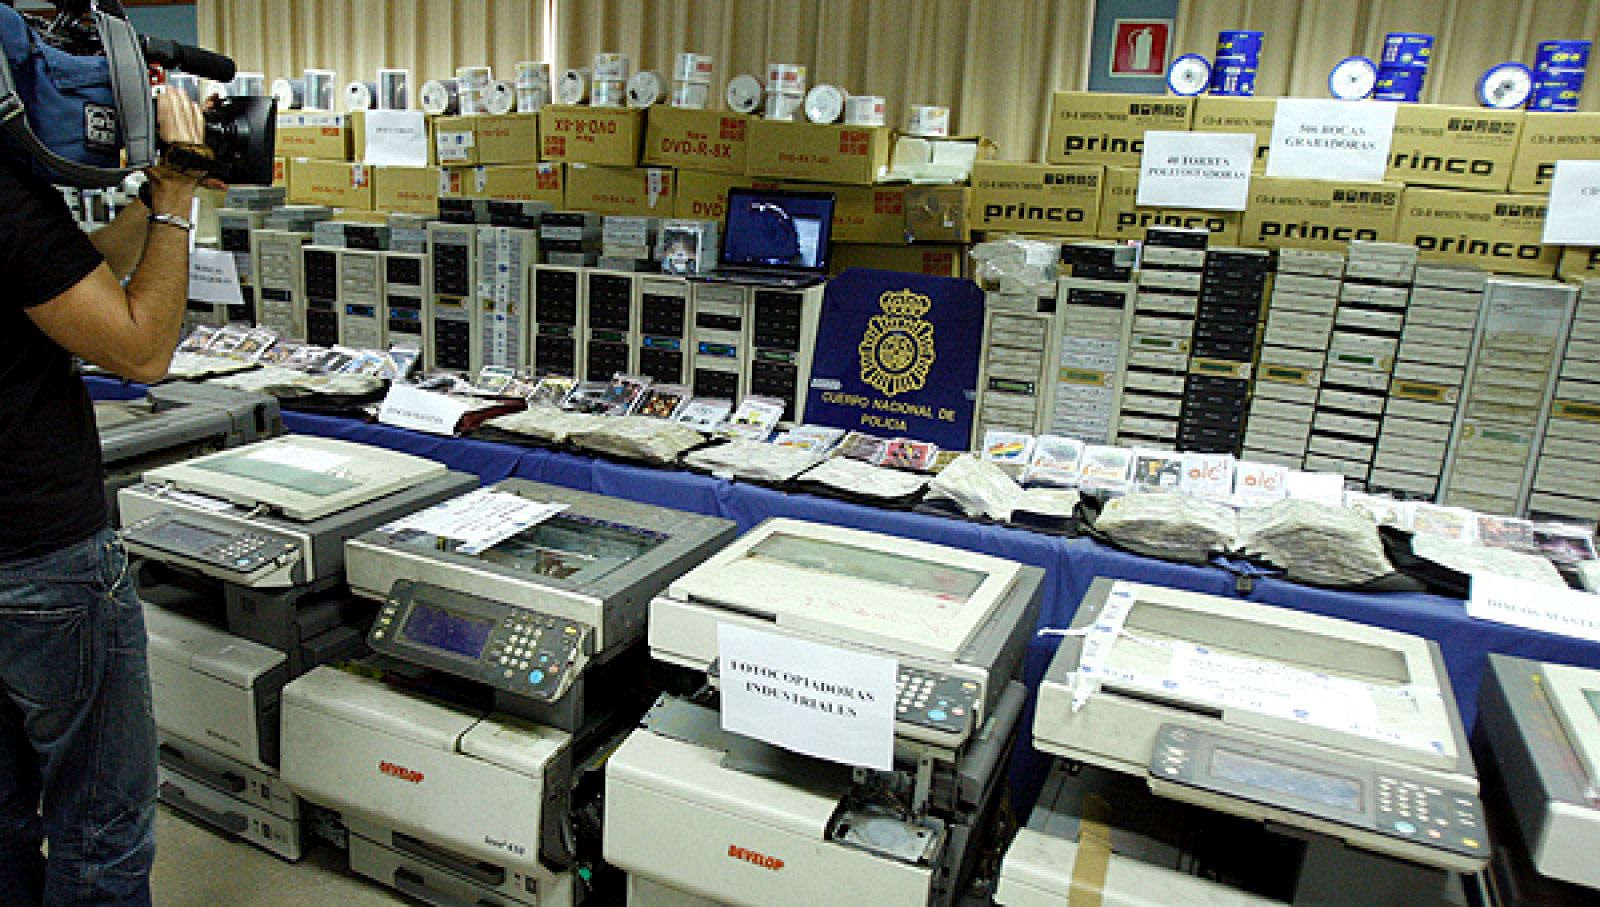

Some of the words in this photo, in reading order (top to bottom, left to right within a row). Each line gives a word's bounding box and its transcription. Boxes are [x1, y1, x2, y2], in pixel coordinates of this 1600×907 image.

[1063, 133, 1144, 156] princ
[1387, 150, 1494, 177] rinco
[983, 202, 1085, 222] princo
[1116, 210, 1225, 234] princo
[1258, 220, 1378, 241] princo
[1414, 233, 1541, 260] princo
[821, 391, 870, 409] CUERPO
[872, 398, 933, 419] NACIONAL
[937, 407, 956, 422] DE
[730, 659, 876, 702] FOTOCOPIADORAS
[745, 681, 858, 718] INDUSTRIALES
[378, 759, 425, 784] DEVELOP
[727, 843, 785, 872] DEVELOP
